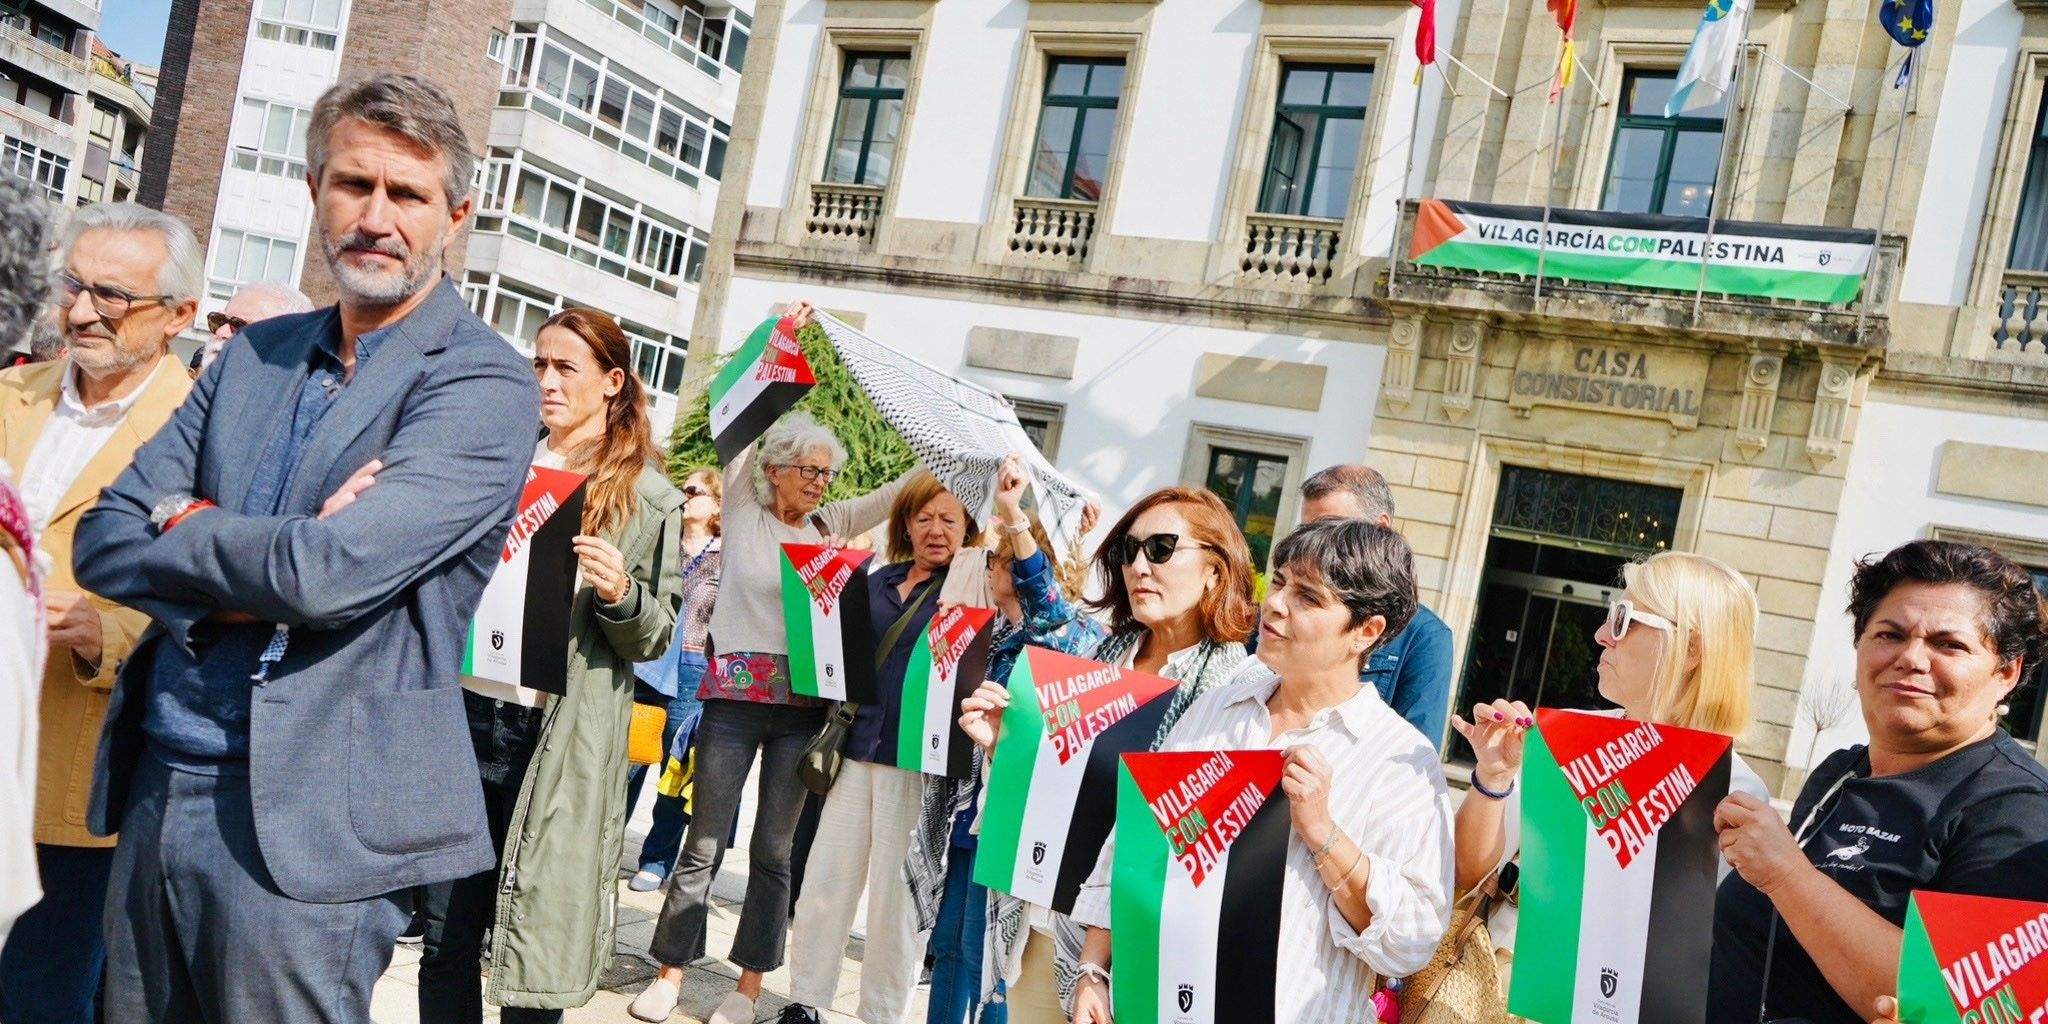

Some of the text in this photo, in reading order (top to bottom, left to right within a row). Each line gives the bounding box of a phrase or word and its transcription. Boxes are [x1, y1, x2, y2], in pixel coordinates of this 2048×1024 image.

[1574, 347, 1648, 380] CASA
[1514, 370, 1699, 416] CONSISTORIAL
[503, 491, 560, 560] ALESTINA
[814, 563, 853, 616] PALESTINA
[934, 625, 976, 682] PALESTINA
[1043, 699, 1082, 736] CON
[1047, 692, 1138, 767] PALESTINA
[1582, 778, 1632, 830] CON
[1597, 762, 1697, 871] PALESTINA
[1166, 806, 1208, 857] CON
[1176, 781, 1266, 889] PALESTINA
[1839, 823, 1901, 843] MOTO BAZAR
